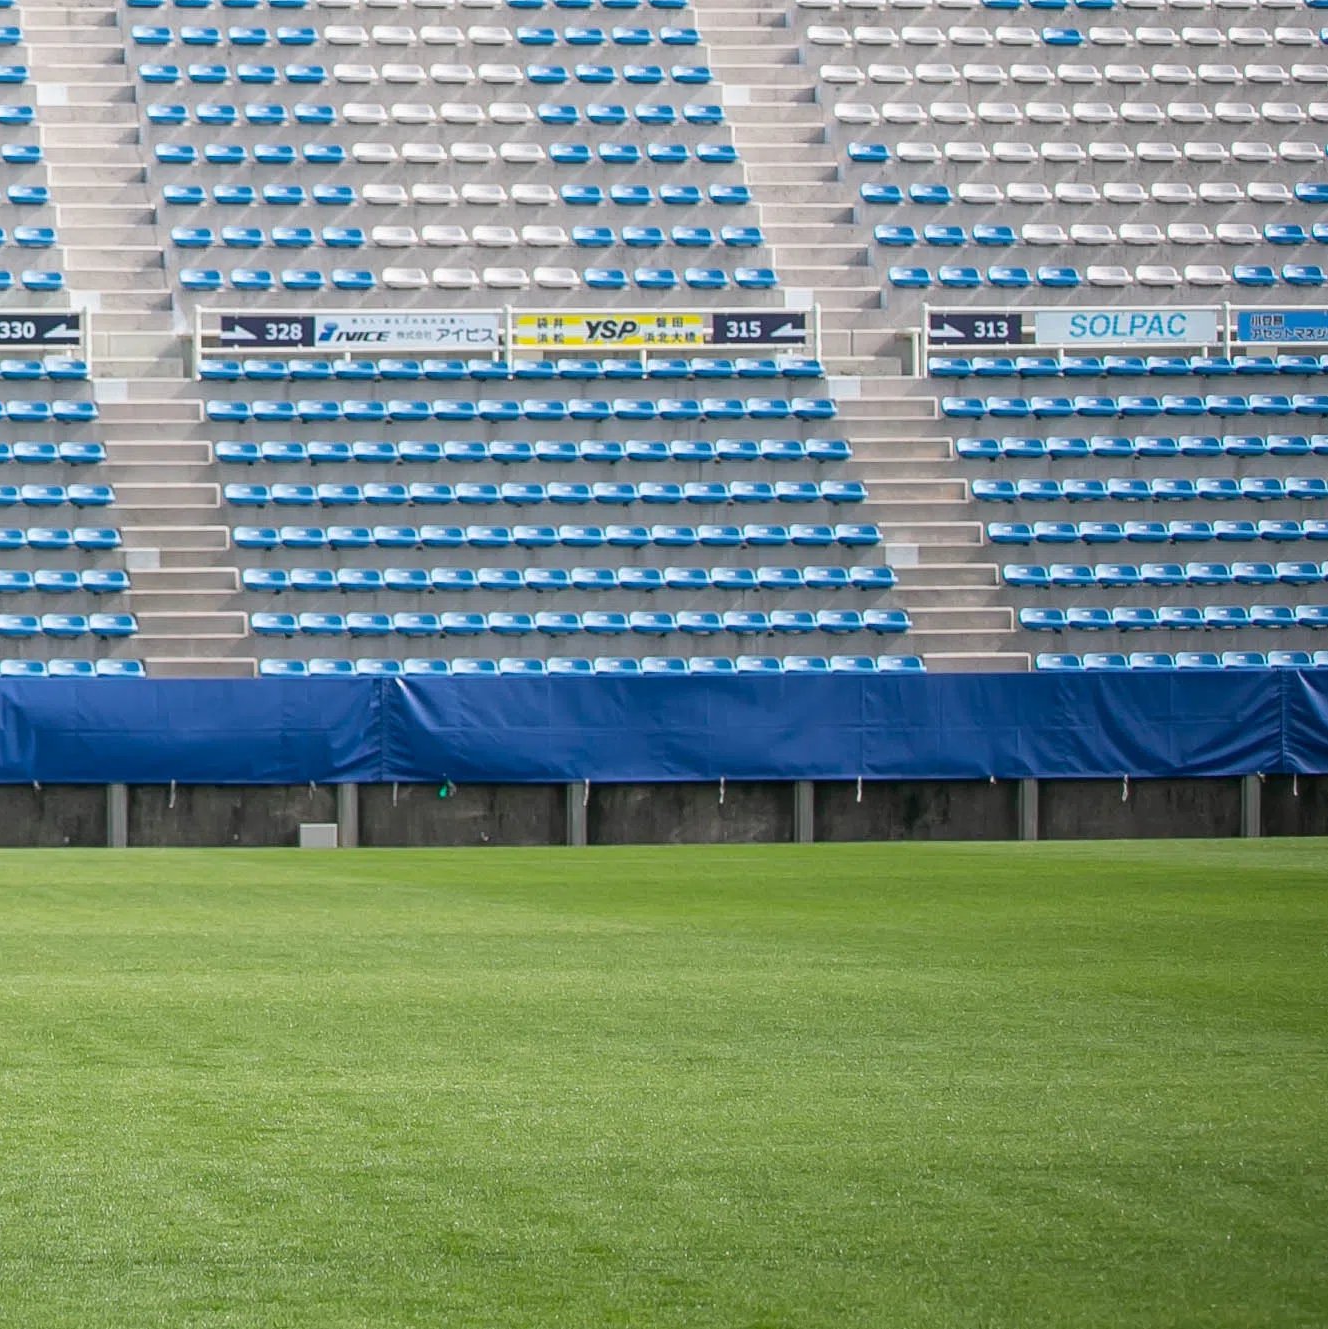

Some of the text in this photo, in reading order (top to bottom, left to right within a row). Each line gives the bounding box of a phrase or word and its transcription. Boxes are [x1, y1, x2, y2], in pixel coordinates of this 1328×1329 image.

[266, 323, 302, 340] 328
[584, 319, 640, 342] YSP
[727, 321, 761, 337] 315
[975, 321, 1008, 337] 313
[1069, 313, 1187, 338] SOLPAC
